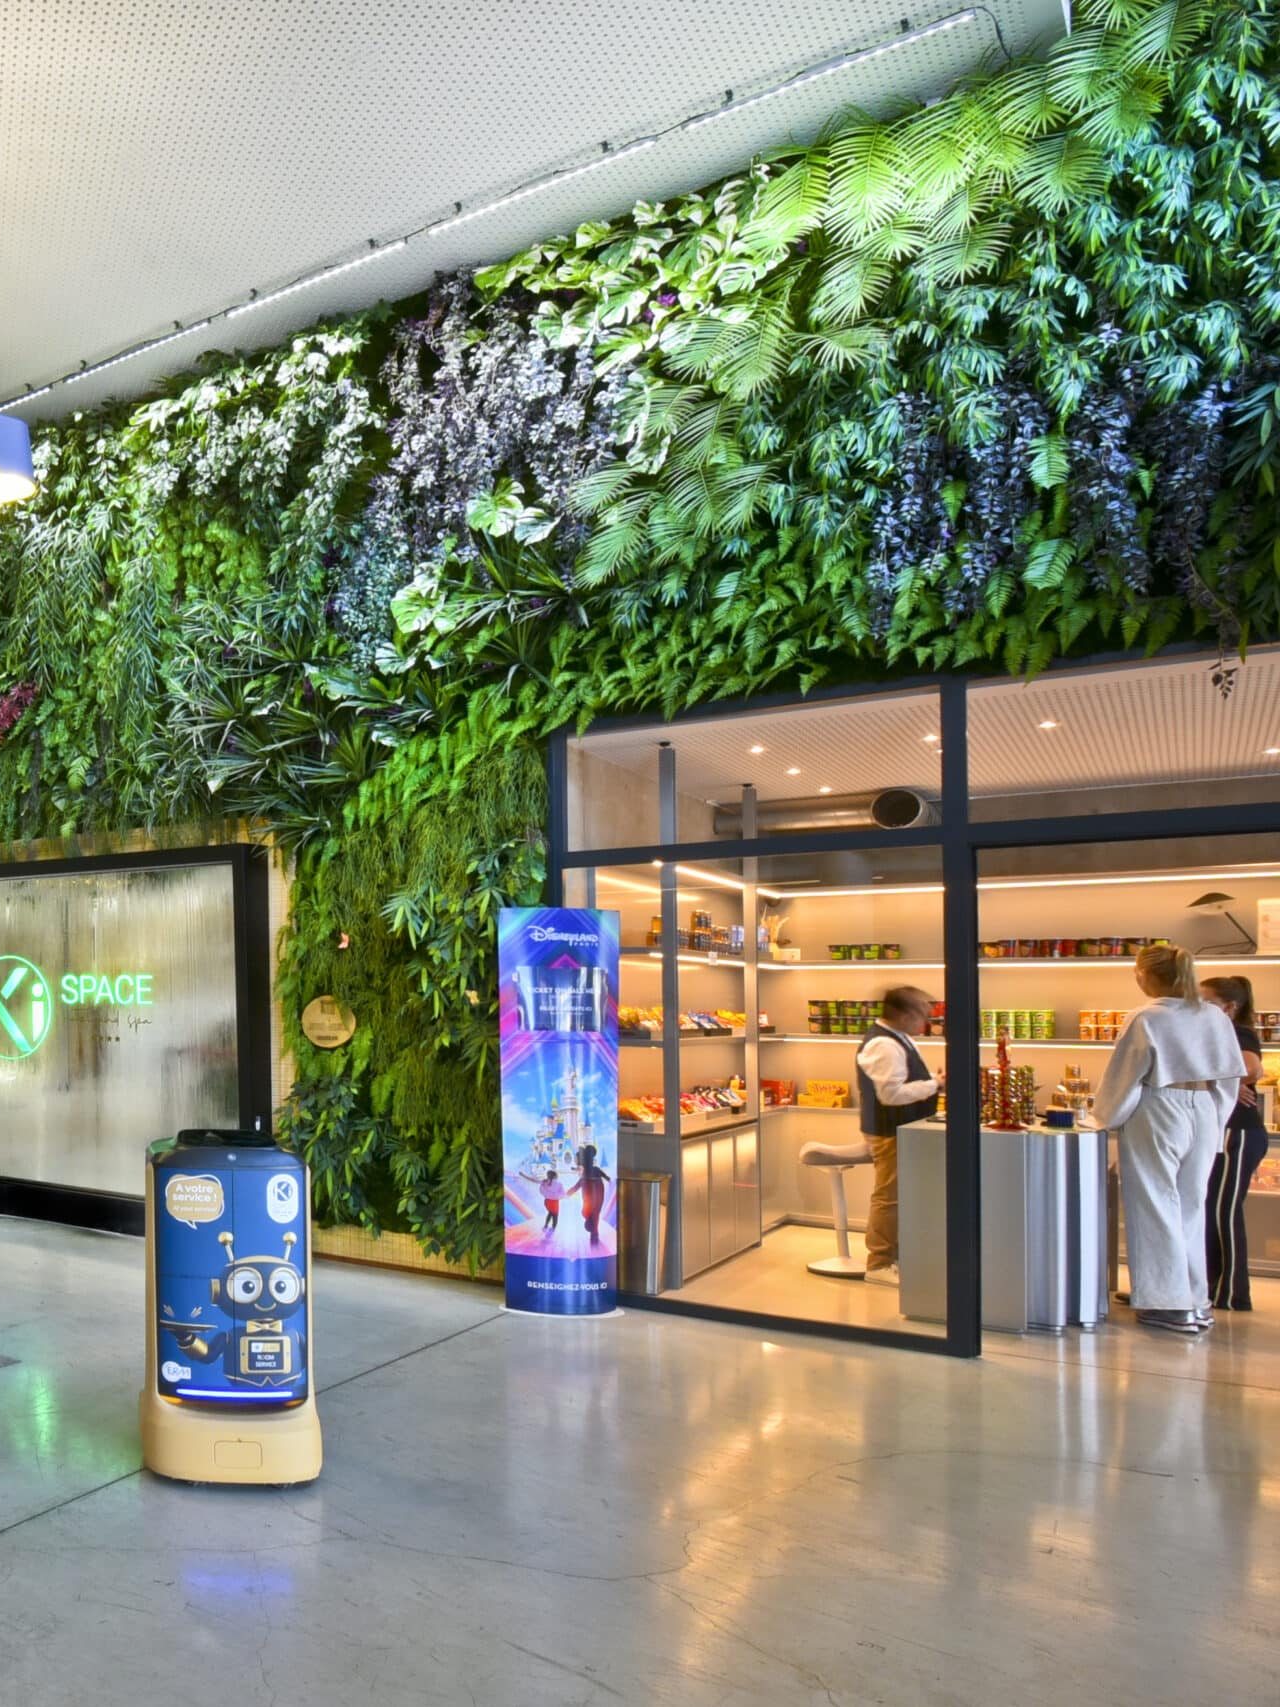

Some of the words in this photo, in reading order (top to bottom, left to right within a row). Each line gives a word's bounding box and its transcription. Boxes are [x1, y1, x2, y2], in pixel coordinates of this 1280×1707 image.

[60, 974, 154, 1005] SPACE
[184, 1184, 214, 1194] votre
[172, 1193, 211, 1203] service
